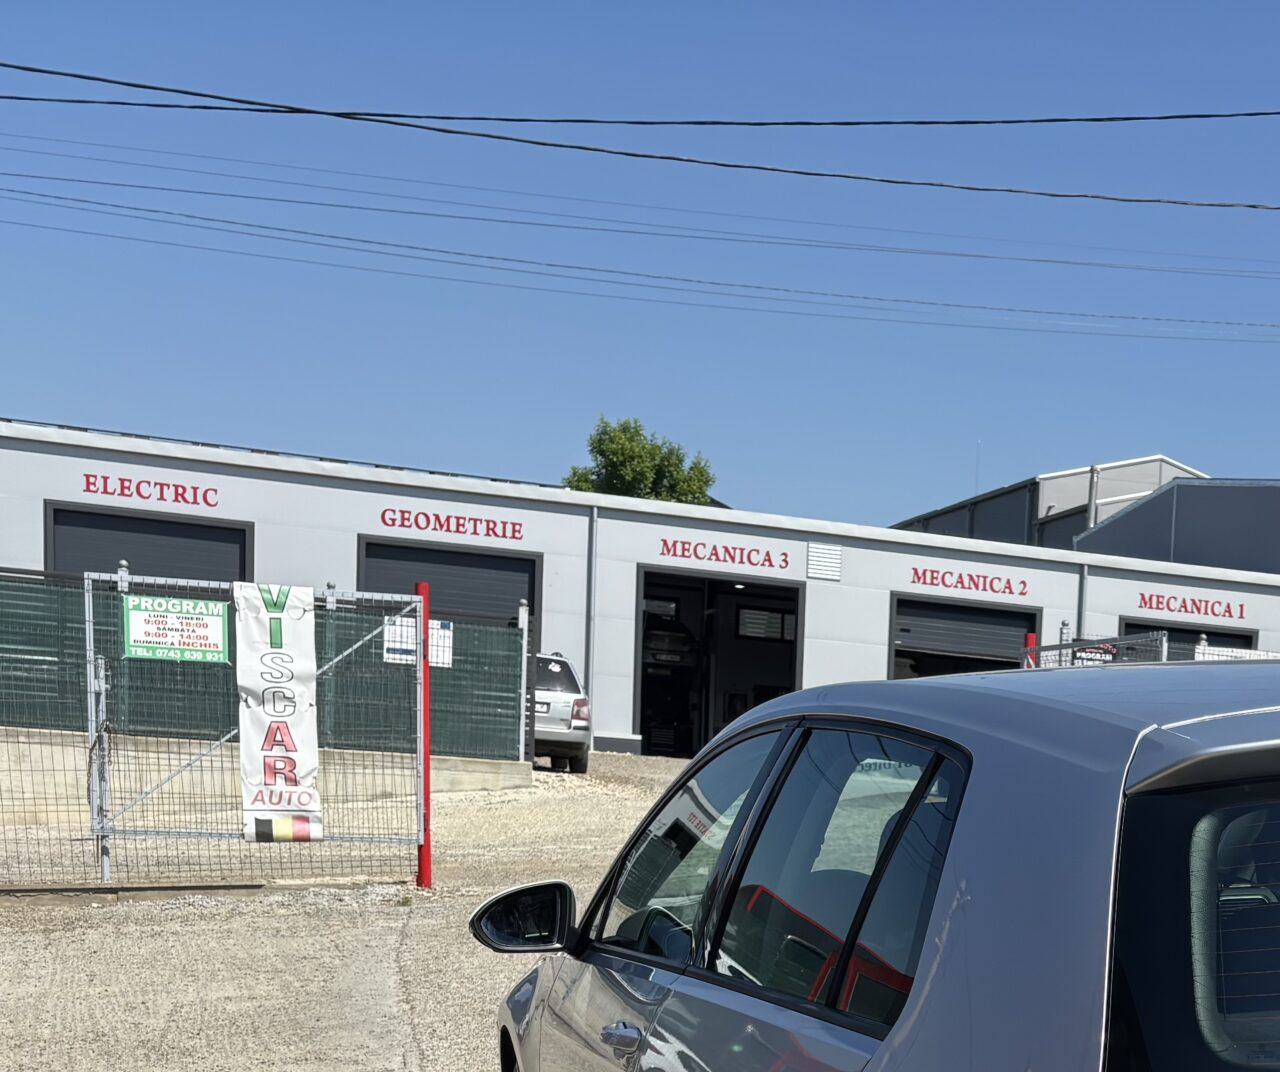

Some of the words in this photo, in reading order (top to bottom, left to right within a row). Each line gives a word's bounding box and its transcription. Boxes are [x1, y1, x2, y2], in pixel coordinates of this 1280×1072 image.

[83, 473, 219, 507] ELECTRIC
[380, 508, 523, 540] GEOMETRIE
[659, 538, 774, 568] MECANICA
[779, 552, 789, 569] 3
[910, 567, 1014, 595] MECANICA
[1018, 580, 1028, 596] 2
[127, 596, 224, 616] PROGRAM
[1138, 592, 1234, 618] MECANICA
[1238, 603, 1246, 620] 1
[144, 618, 168, 626] 9:00
[179, 620, 209, 629] 18:00
[144, 630, 168, 638] 9:00
[179, 633, 209, 641] 14:00
[156, 648, 181, 658] 0743
[205, 652, 224, 661] 931
[257, 583, 299, 787] VISCAR
[251, 789, 313, 806] AUTO
